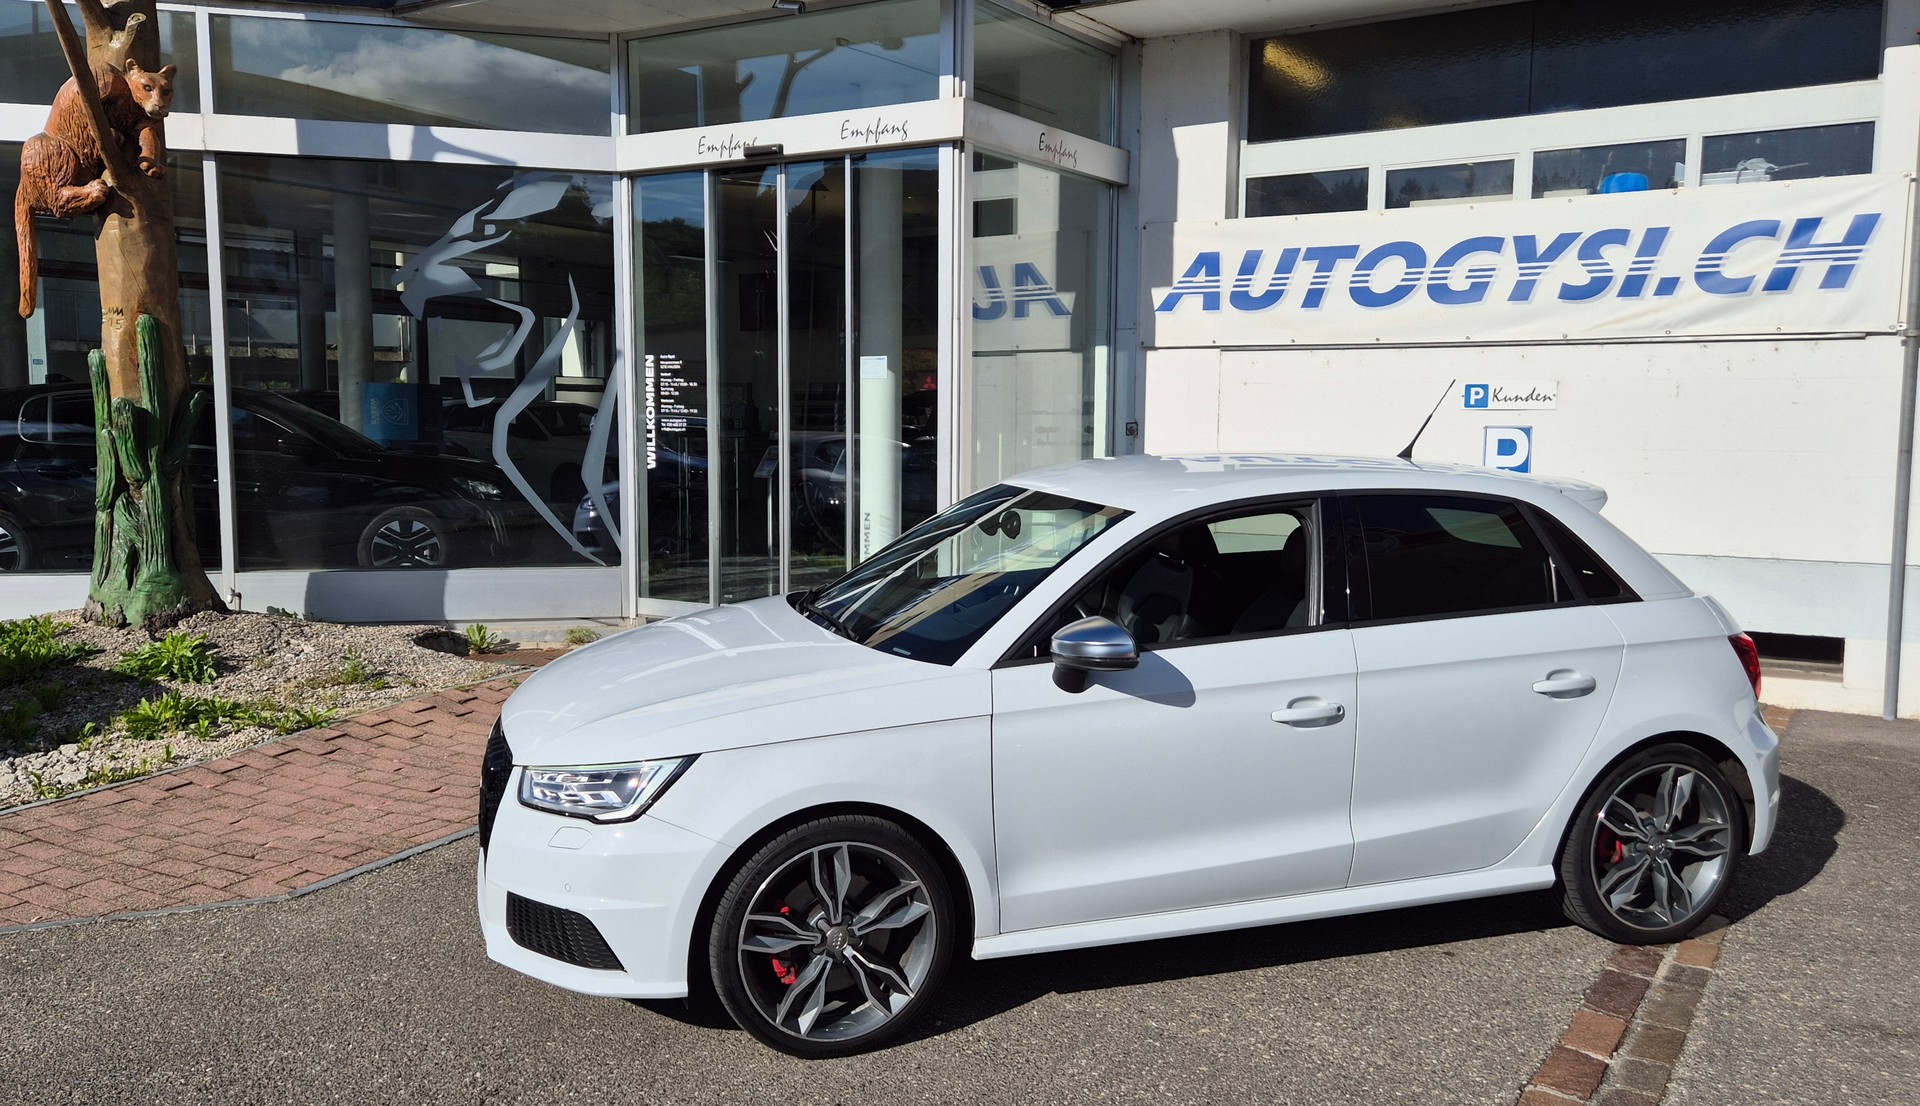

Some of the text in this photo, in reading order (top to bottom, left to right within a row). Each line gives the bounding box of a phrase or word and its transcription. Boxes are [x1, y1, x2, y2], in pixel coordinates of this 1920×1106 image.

[840, 116, 908, 144] Empfang
[1038, 131, 1078, 169] Empfang
[1153, 212, 1885, 313] AUTOGYSI.CH
[645, 354, 657, 470] WILLKOMMEN
[1492, 386, 1553, 403] Kunden
